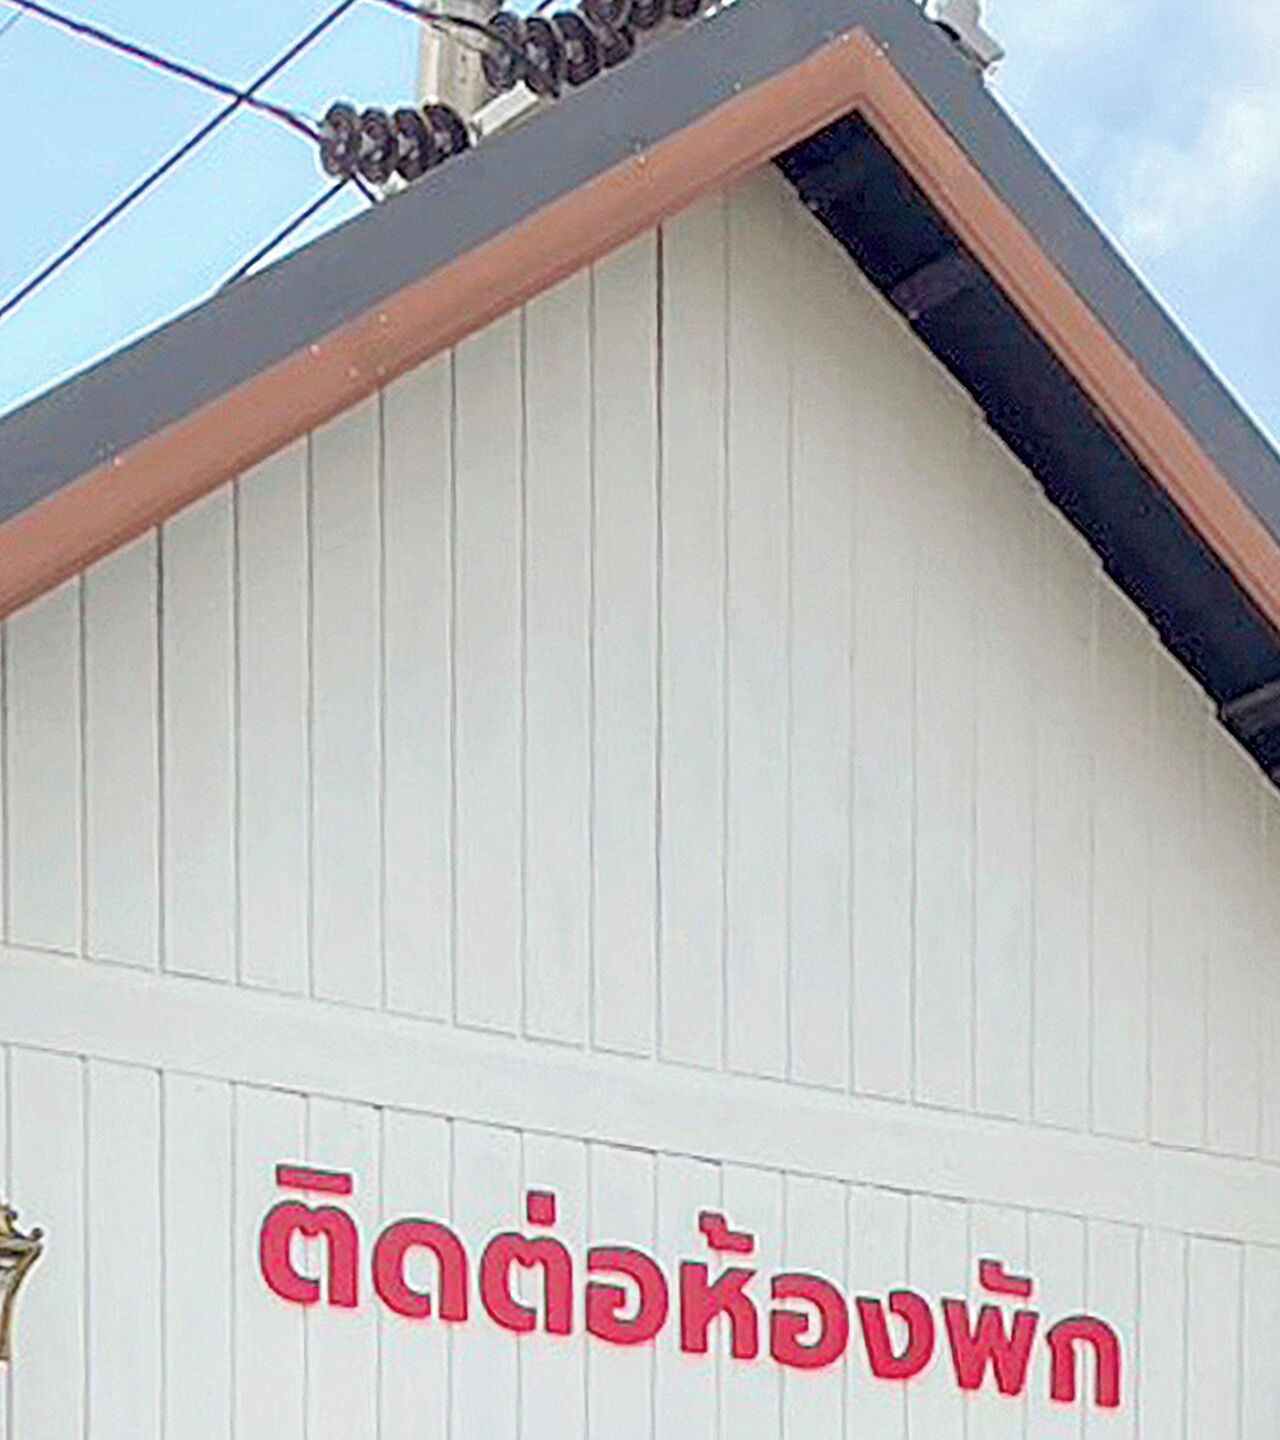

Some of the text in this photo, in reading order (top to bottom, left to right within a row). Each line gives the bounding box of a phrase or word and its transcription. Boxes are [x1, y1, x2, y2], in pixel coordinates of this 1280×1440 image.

[258, 1163, 1123, 1409] ติดต่อห้องพัก
